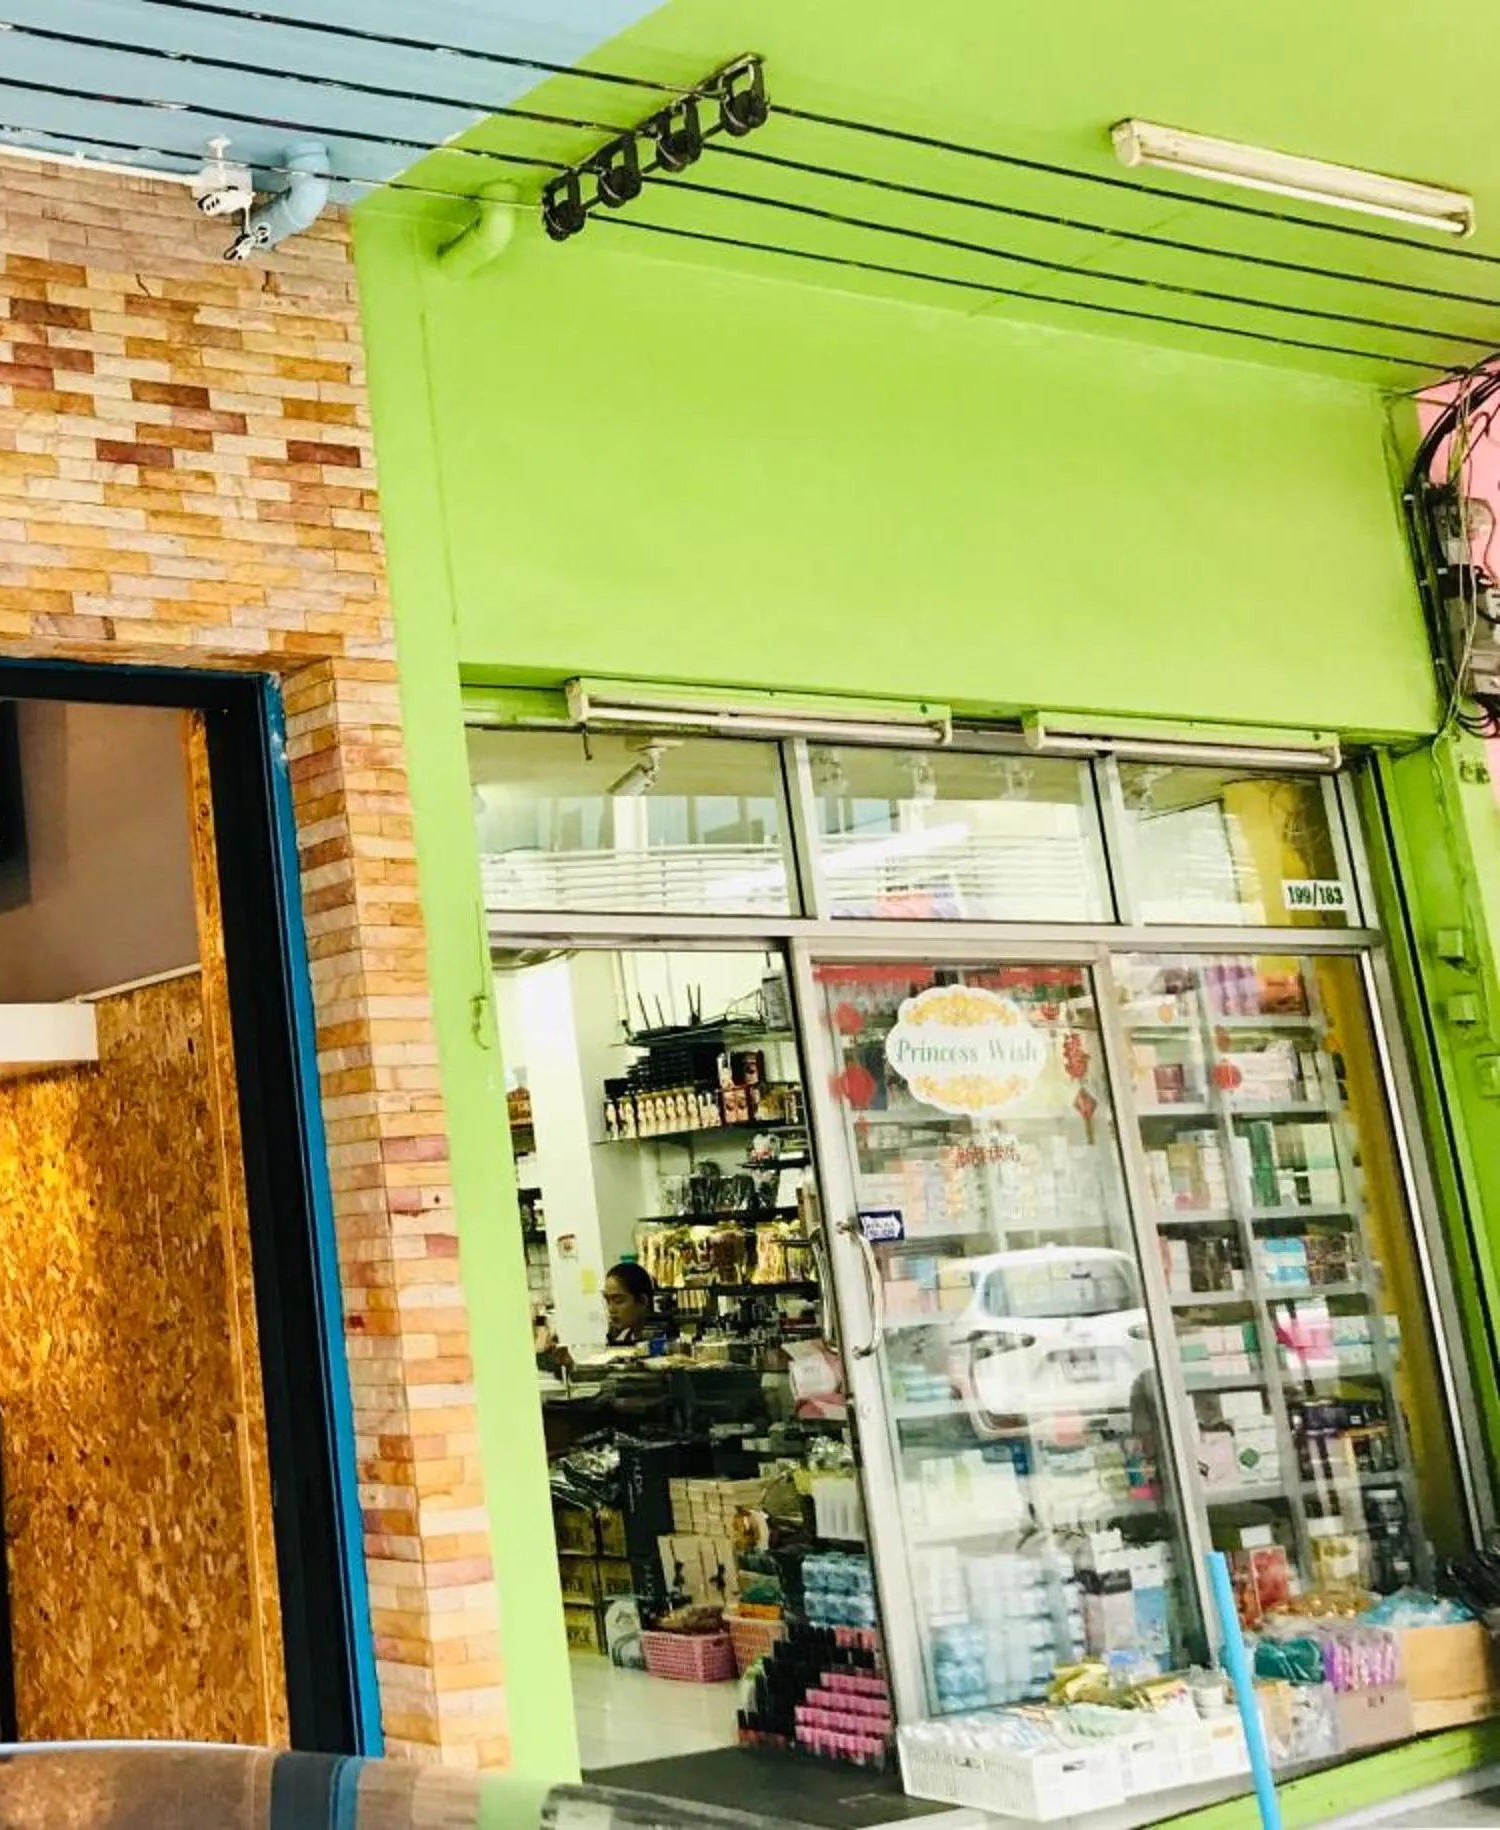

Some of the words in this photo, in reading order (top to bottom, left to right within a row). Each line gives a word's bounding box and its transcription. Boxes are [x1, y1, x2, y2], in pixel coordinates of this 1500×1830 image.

[1287, 882, 1344, 906] 199/183
[897, 1038, 978, 1063] Princess
[988, 1038, 1038, 1063] Wish
